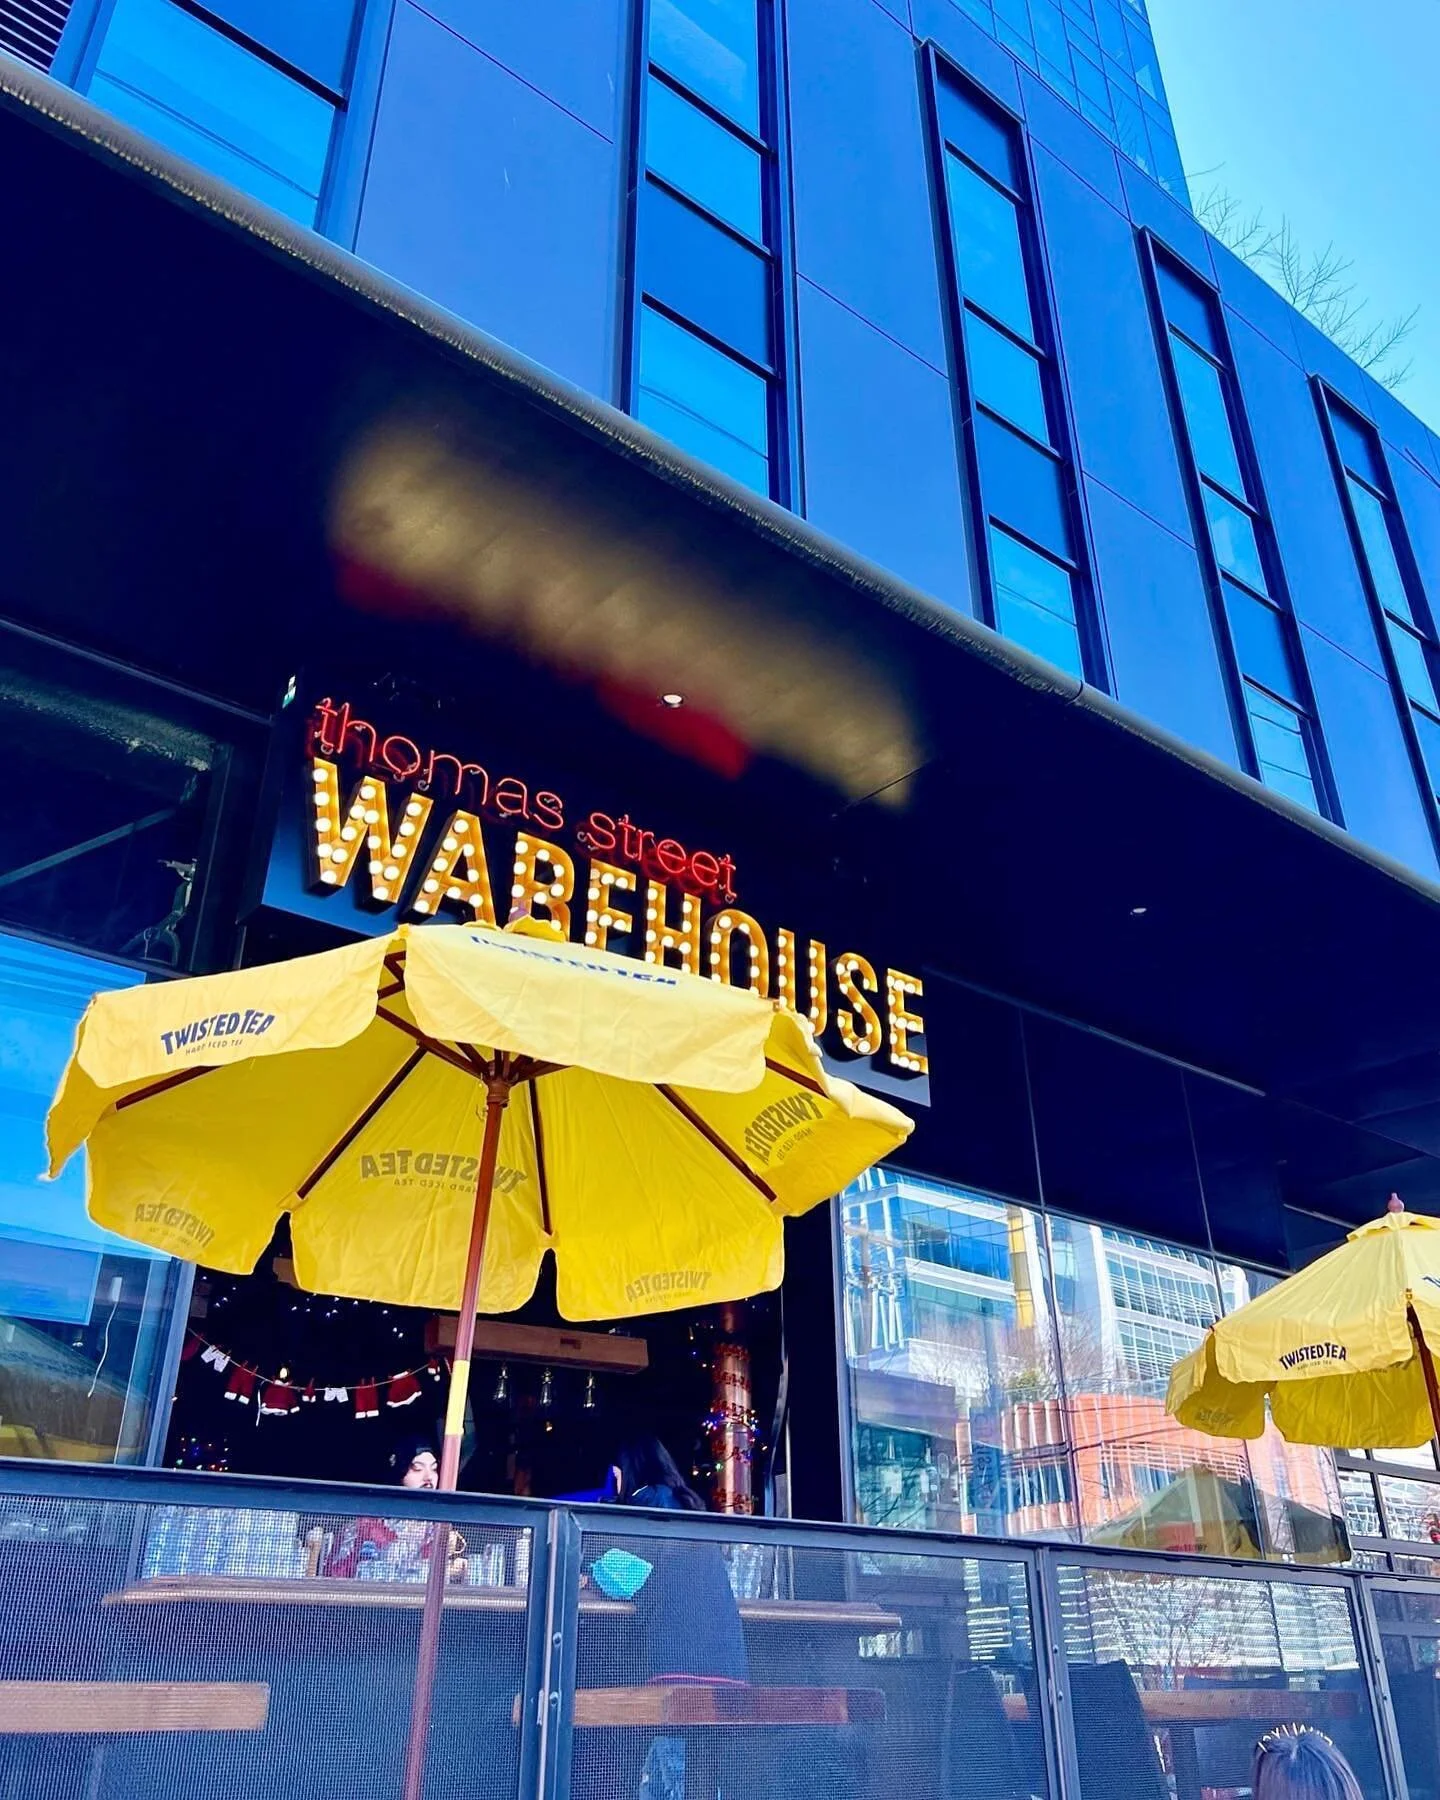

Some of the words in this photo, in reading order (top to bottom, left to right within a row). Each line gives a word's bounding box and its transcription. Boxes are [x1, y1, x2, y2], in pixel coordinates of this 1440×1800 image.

[314, 697, 566, 830] thomas
[582, 811, 738, 900] street
[312, 757, 929, 1075] WAREHOUSE
[160, 1011, 241, 1056] TWISTED
[1278, 1344, 1325, 1370] TWISTED
[1324, 1342, 1347, 1361] TEA
